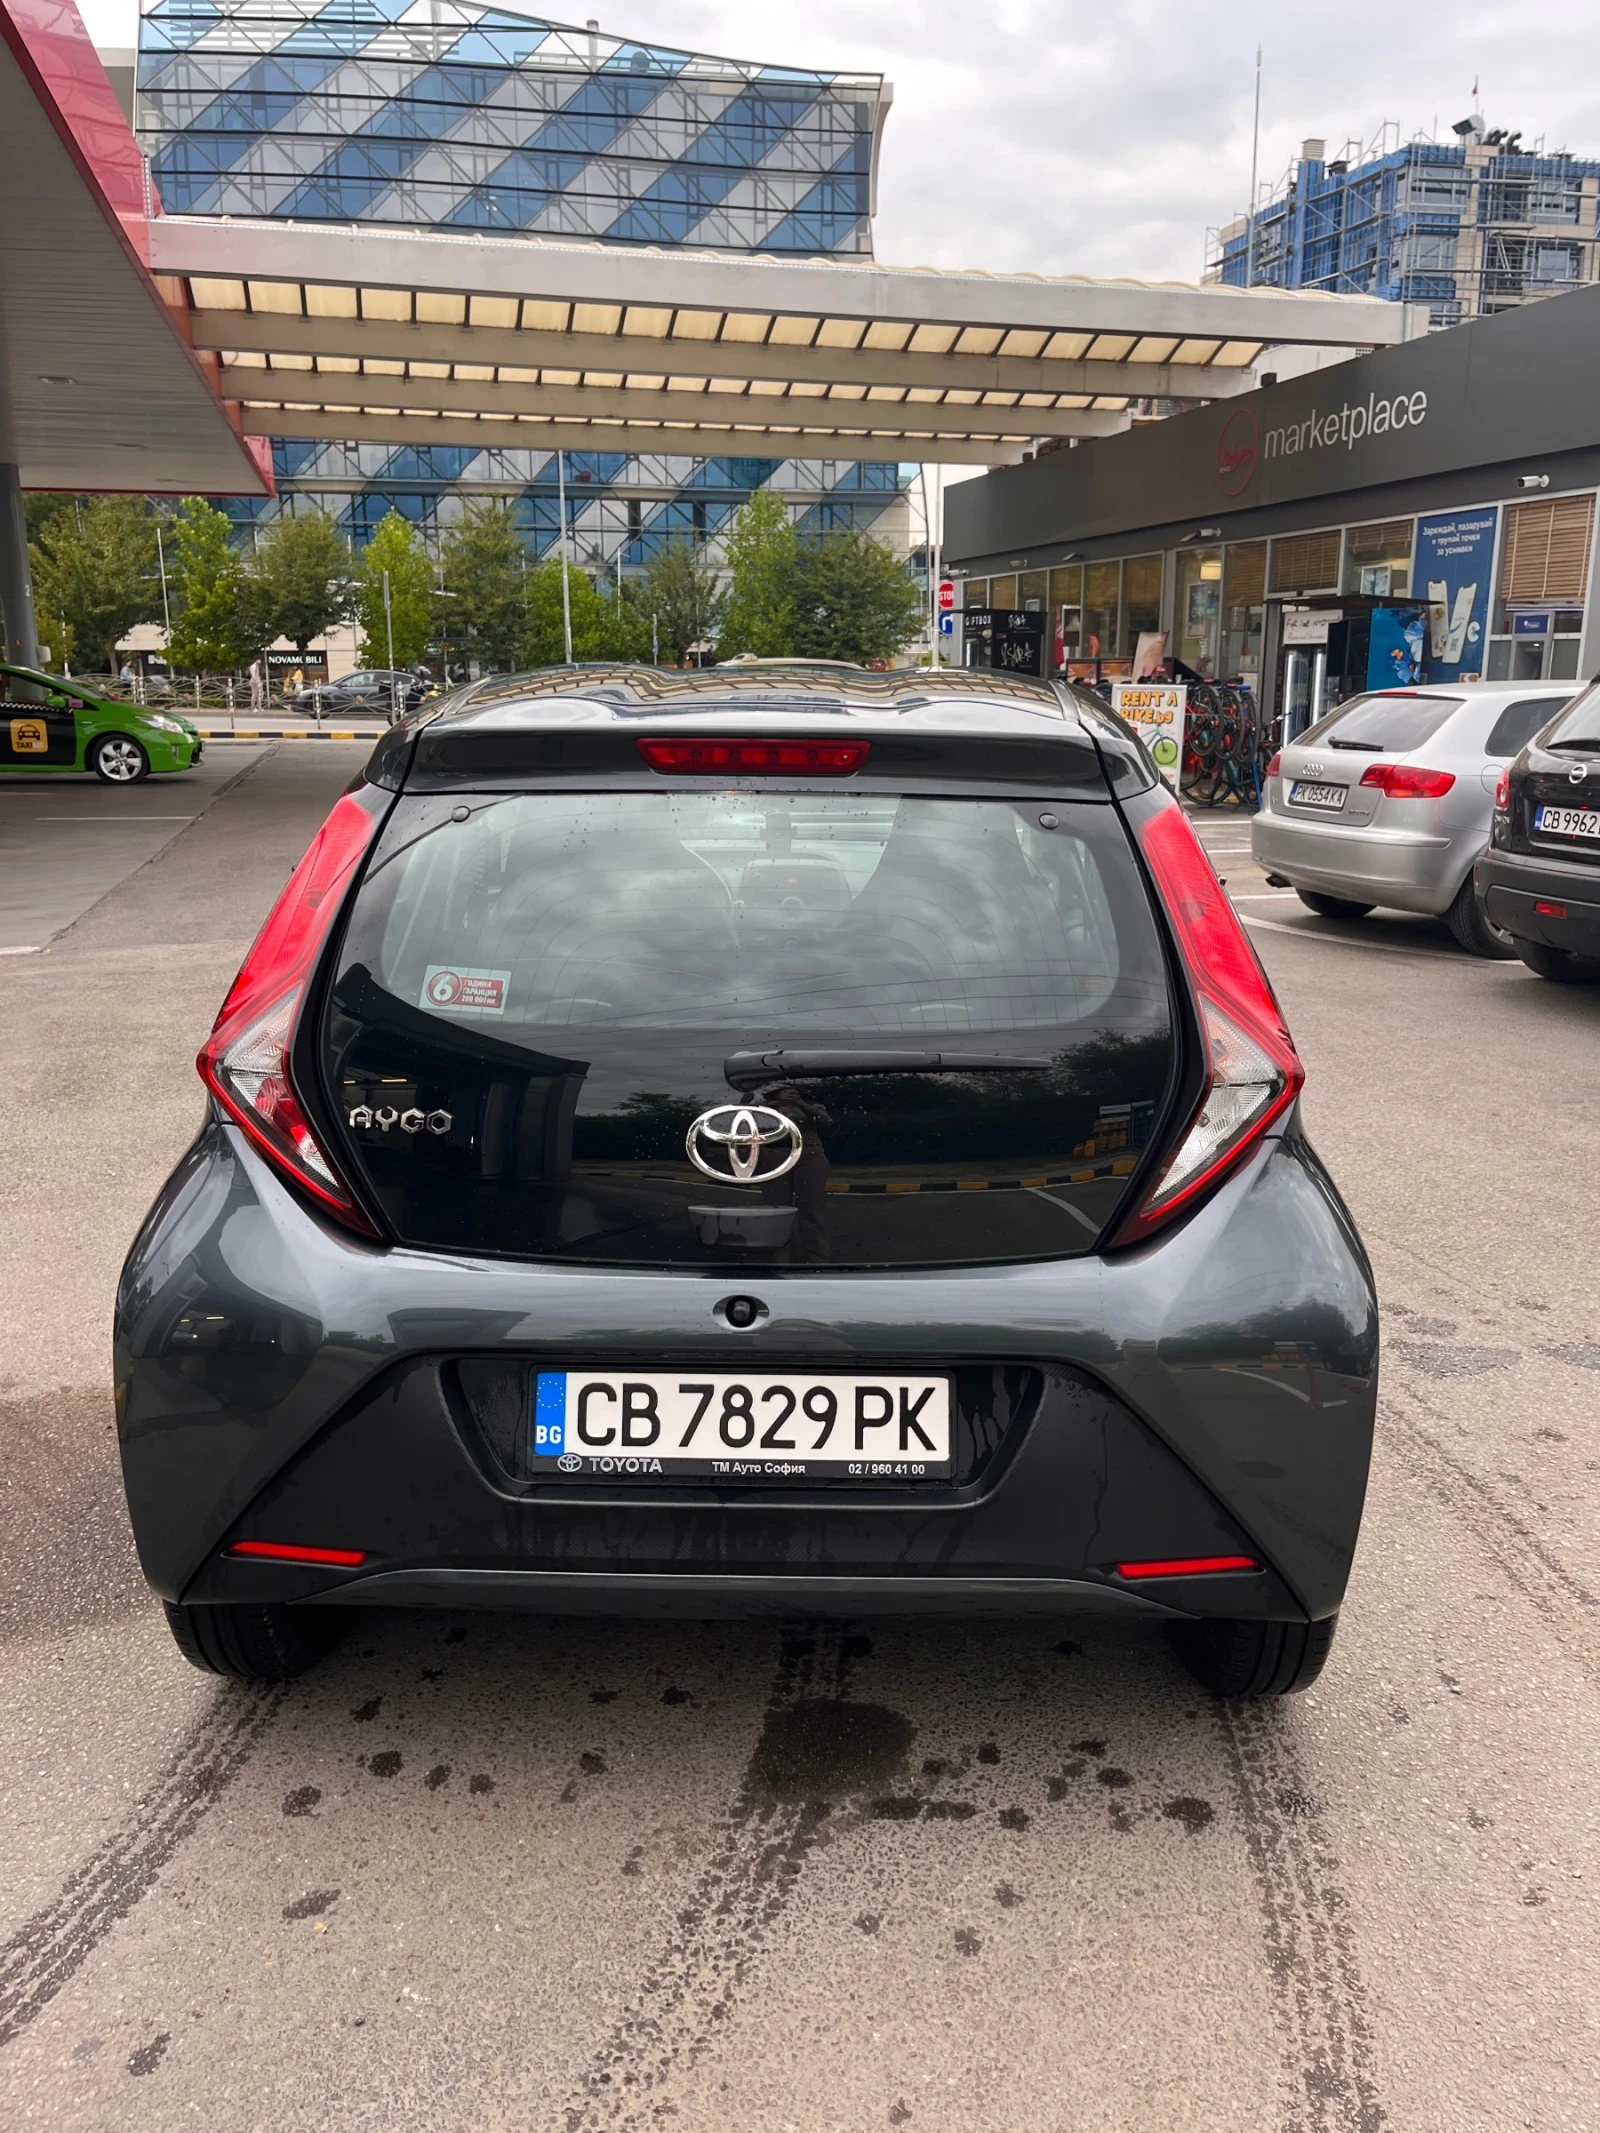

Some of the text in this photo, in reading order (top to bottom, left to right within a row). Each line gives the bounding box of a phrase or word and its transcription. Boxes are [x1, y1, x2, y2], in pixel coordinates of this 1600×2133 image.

[1264, 391, 1427, 459] marketplace
[1423, 517, 1493, 536] Зареждай, пазарувай
[1438, 533, 1460, 546] трупай
[1461, 534, 1480, 542] точки
[1437, 546, 1473, 557] за усмивки
[25, 584, 30, 597] 2
[965, 614, 992, 626] GFTBOX
[1120, 690, 1178, 707] RENT A
[1119, 707, 1174, 724] BIKE.bg
[1295, 785, 1343, 804] PK 0554 KA
[1543, 810, 1597, 834] CB 9962
[433, 974, 452, 1001] 6
[462, 987, 497, 997] ГАРАНЦИЯ
[461, 994, 473, 1003] 200
[349, 1104, 454, 1135] AYGO
[536, 1382, 937, 1451] BG CB 7829 PK
[589, 1457, 663, 1473] TOYOTA
[712, 1461, 730, 1473] ТМ
[733, 1462, 761, 1475] Ауто
[764, 1462, 806, 1476] София
[848, 1463, 862, 1474] 02
[872, 1464, 892, 1475] 960
[895, 1464, 908, 1475] 41
[911, 1464, 925, 1475] 00
